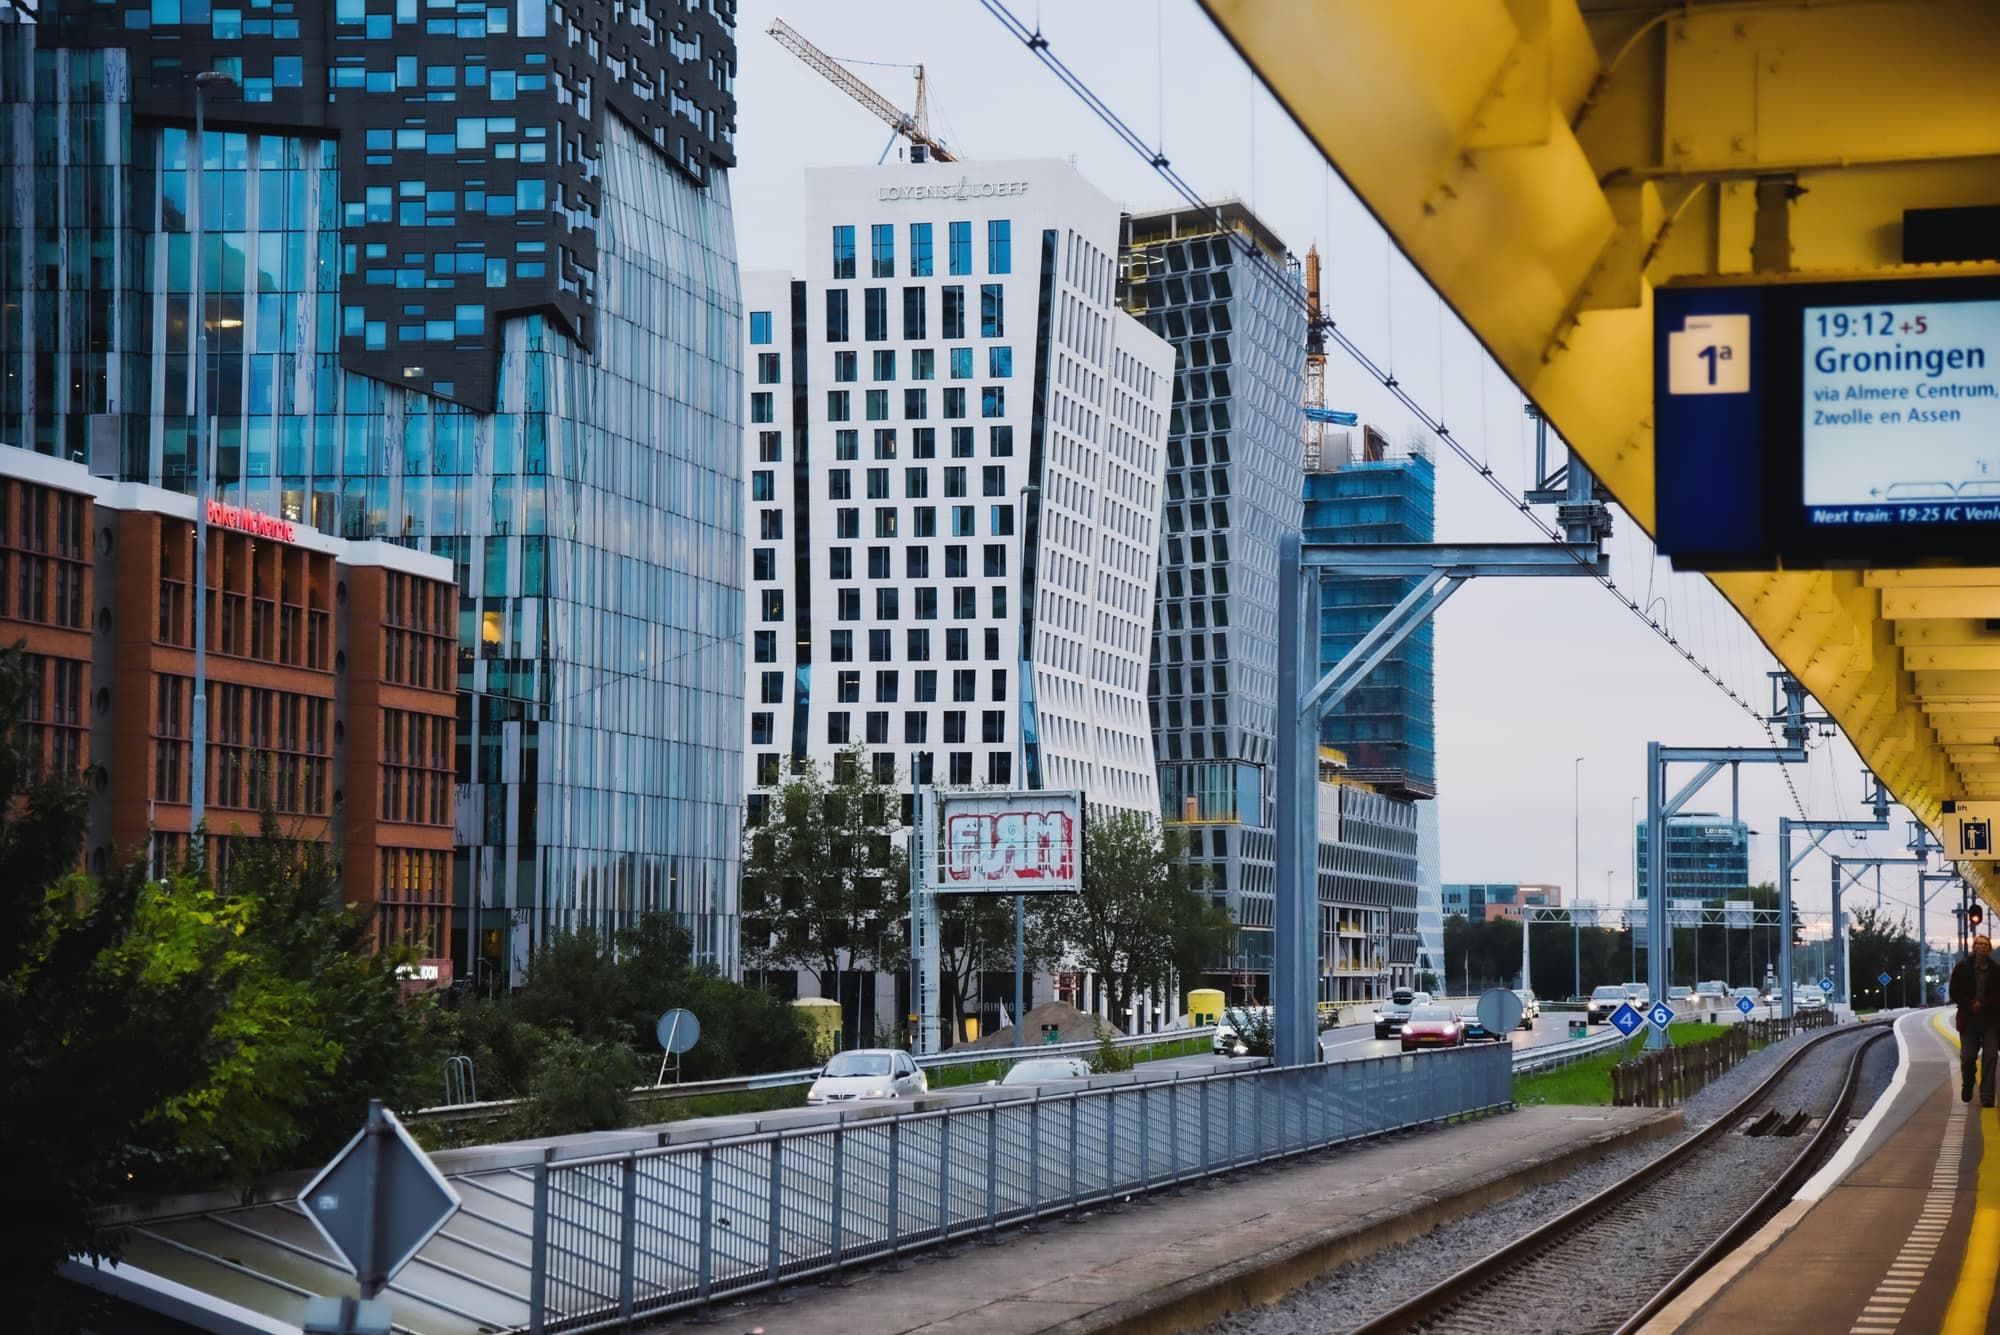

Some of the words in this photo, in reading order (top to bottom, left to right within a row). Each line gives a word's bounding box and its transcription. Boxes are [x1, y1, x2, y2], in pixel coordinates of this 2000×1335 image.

[878, 184, 951, 201] LOYENS
[971, 181, 1029, 199] LOEFF
[1816, 311, 1895, 338] 19:12
[1899, 315, 1928, 335] +5
[1814, 343, 1985, 378] Groningen
[1813, 386, 1840, 402] via
[1845, 384, 1909, 401] Almere
[1915, 382, 1999, 399] Centrum,
[1813, 409, 1873, 425] Zwolle
[1879, 412, 1901, 424] en
[1907, 407, 1961, 423] Assen
[206, 498, 241, 528] Baker
[1813, 510, 1848, 523] Next
[1853, 509, 1893, 522] train:
[1899, 508, 1940, 521] 19:25
[1944, 507, 1961, 520] IC
[1619, 1012, 1633, 1027] 4
[1654, 1008, 1667, 1024] 6
